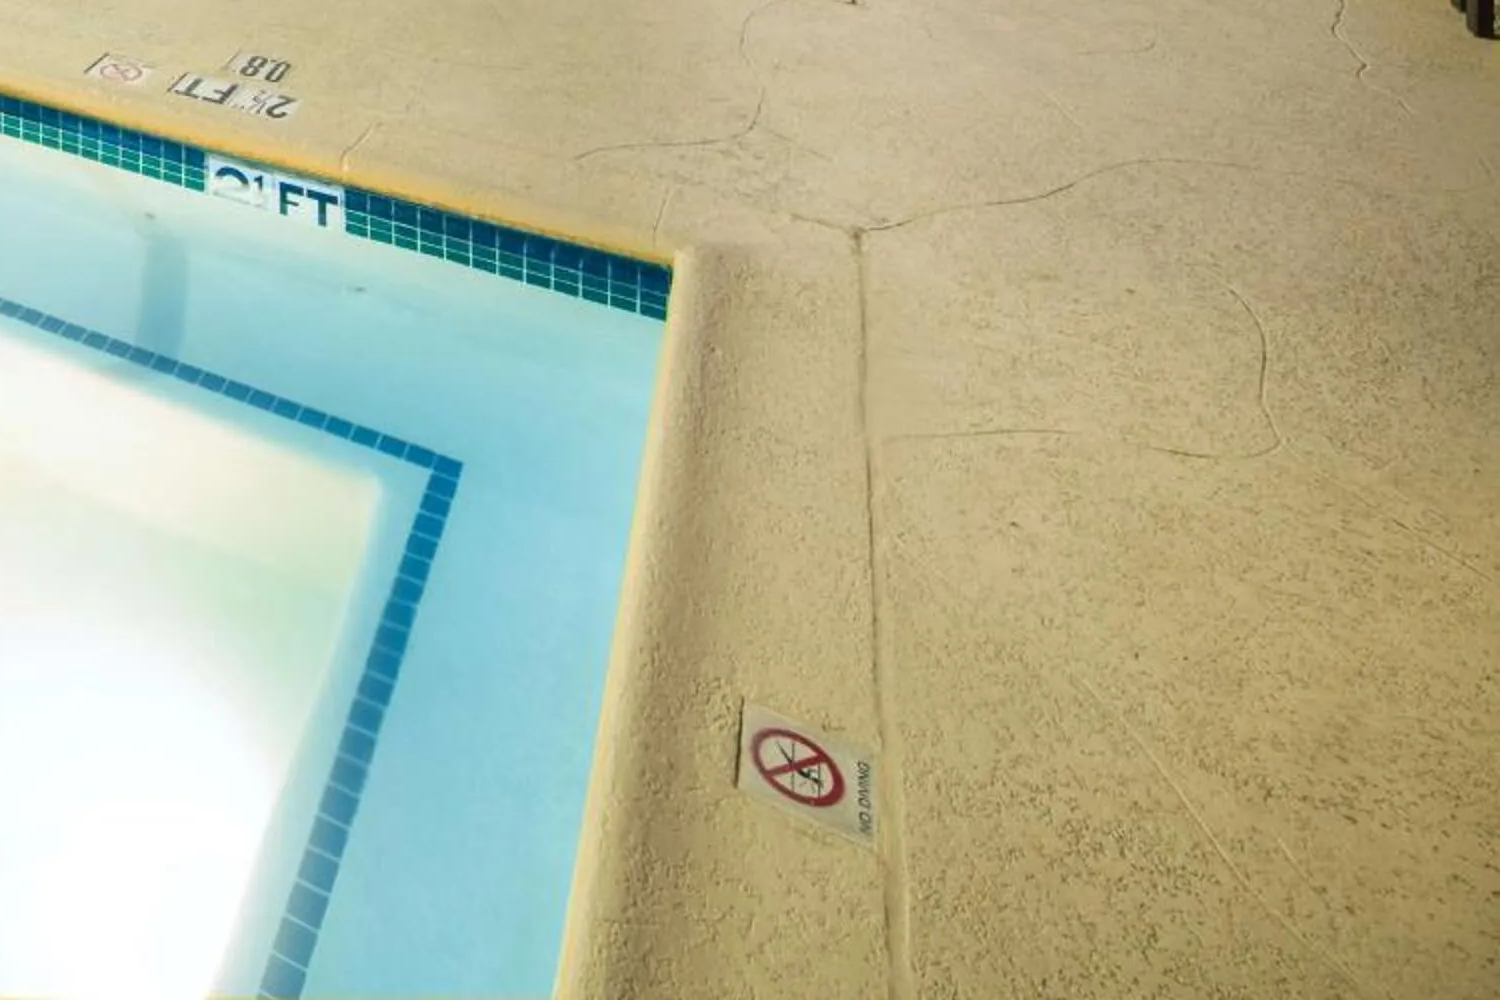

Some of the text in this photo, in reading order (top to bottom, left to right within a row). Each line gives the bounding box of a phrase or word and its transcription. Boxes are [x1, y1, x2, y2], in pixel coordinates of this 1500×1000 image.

[173, 78, 239, 105] FT
[278, 180, 339, 228] FT
[858, 811, 873, 834] NO
